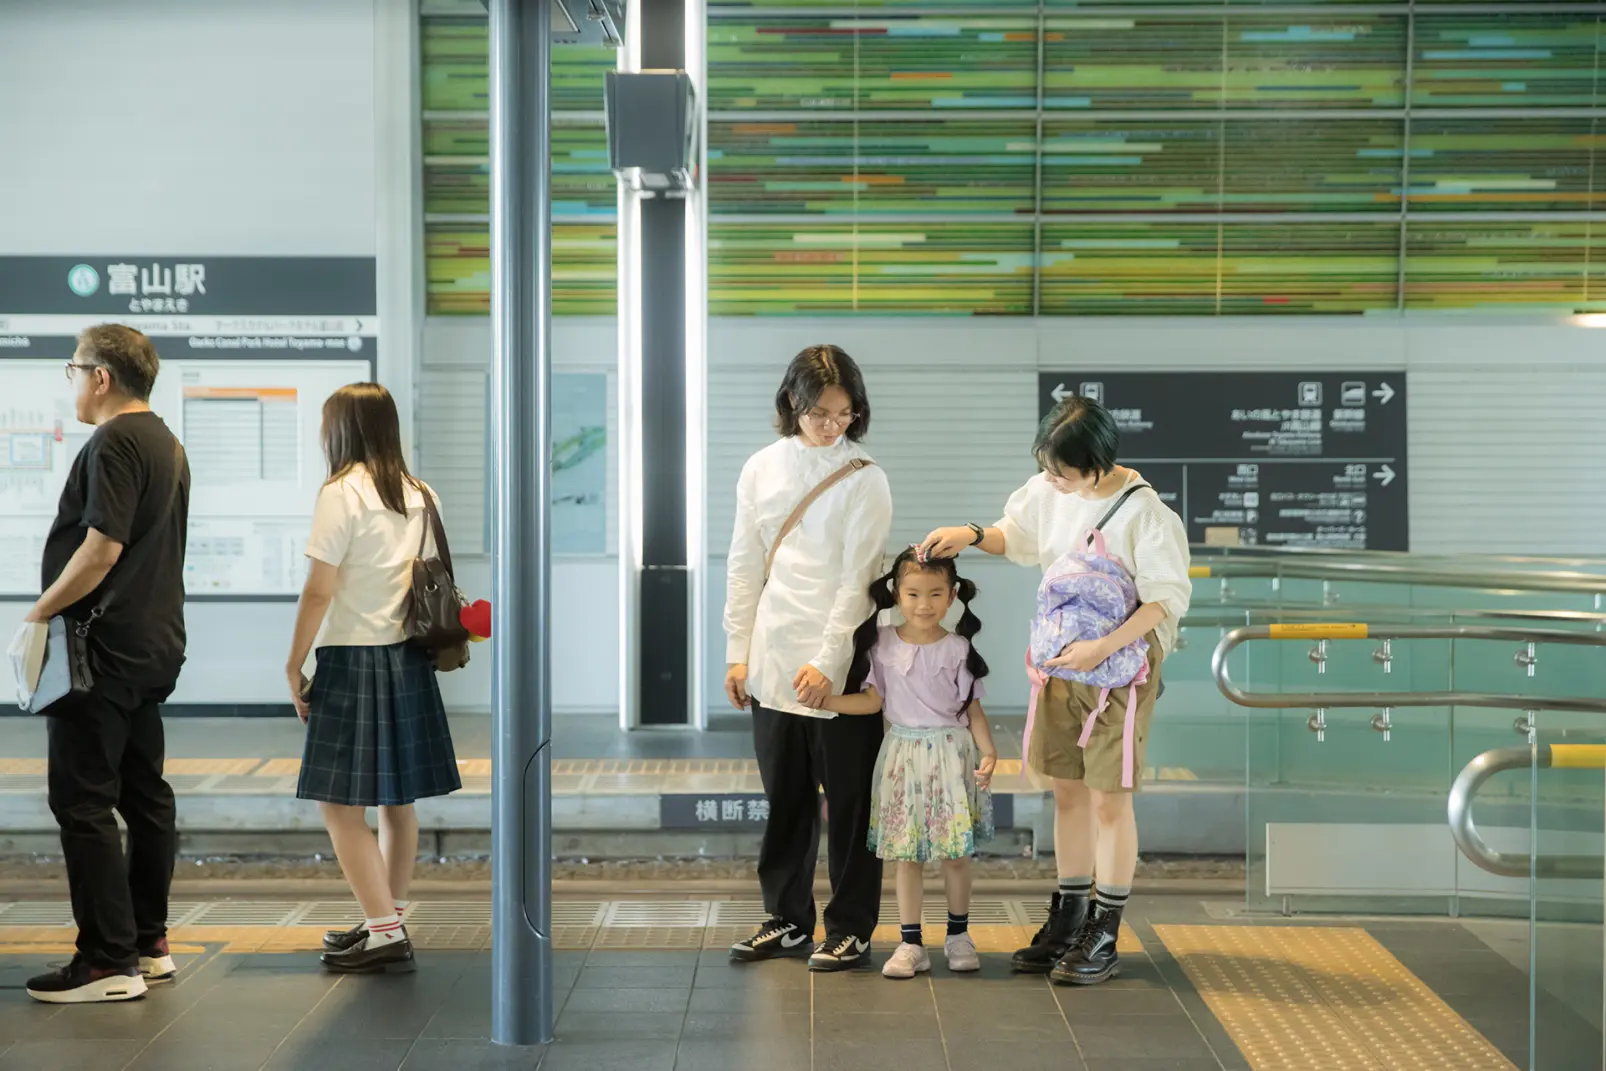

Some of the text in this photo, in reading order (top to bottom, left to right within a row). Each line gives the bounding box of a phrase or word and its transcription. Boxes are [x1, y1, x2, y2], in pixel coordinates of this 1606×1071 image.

[107, 263, 206, 295] 富山駅
[129, 298, 189, 313] とやまえき
[695, 799, 769, 821] 横断禁
